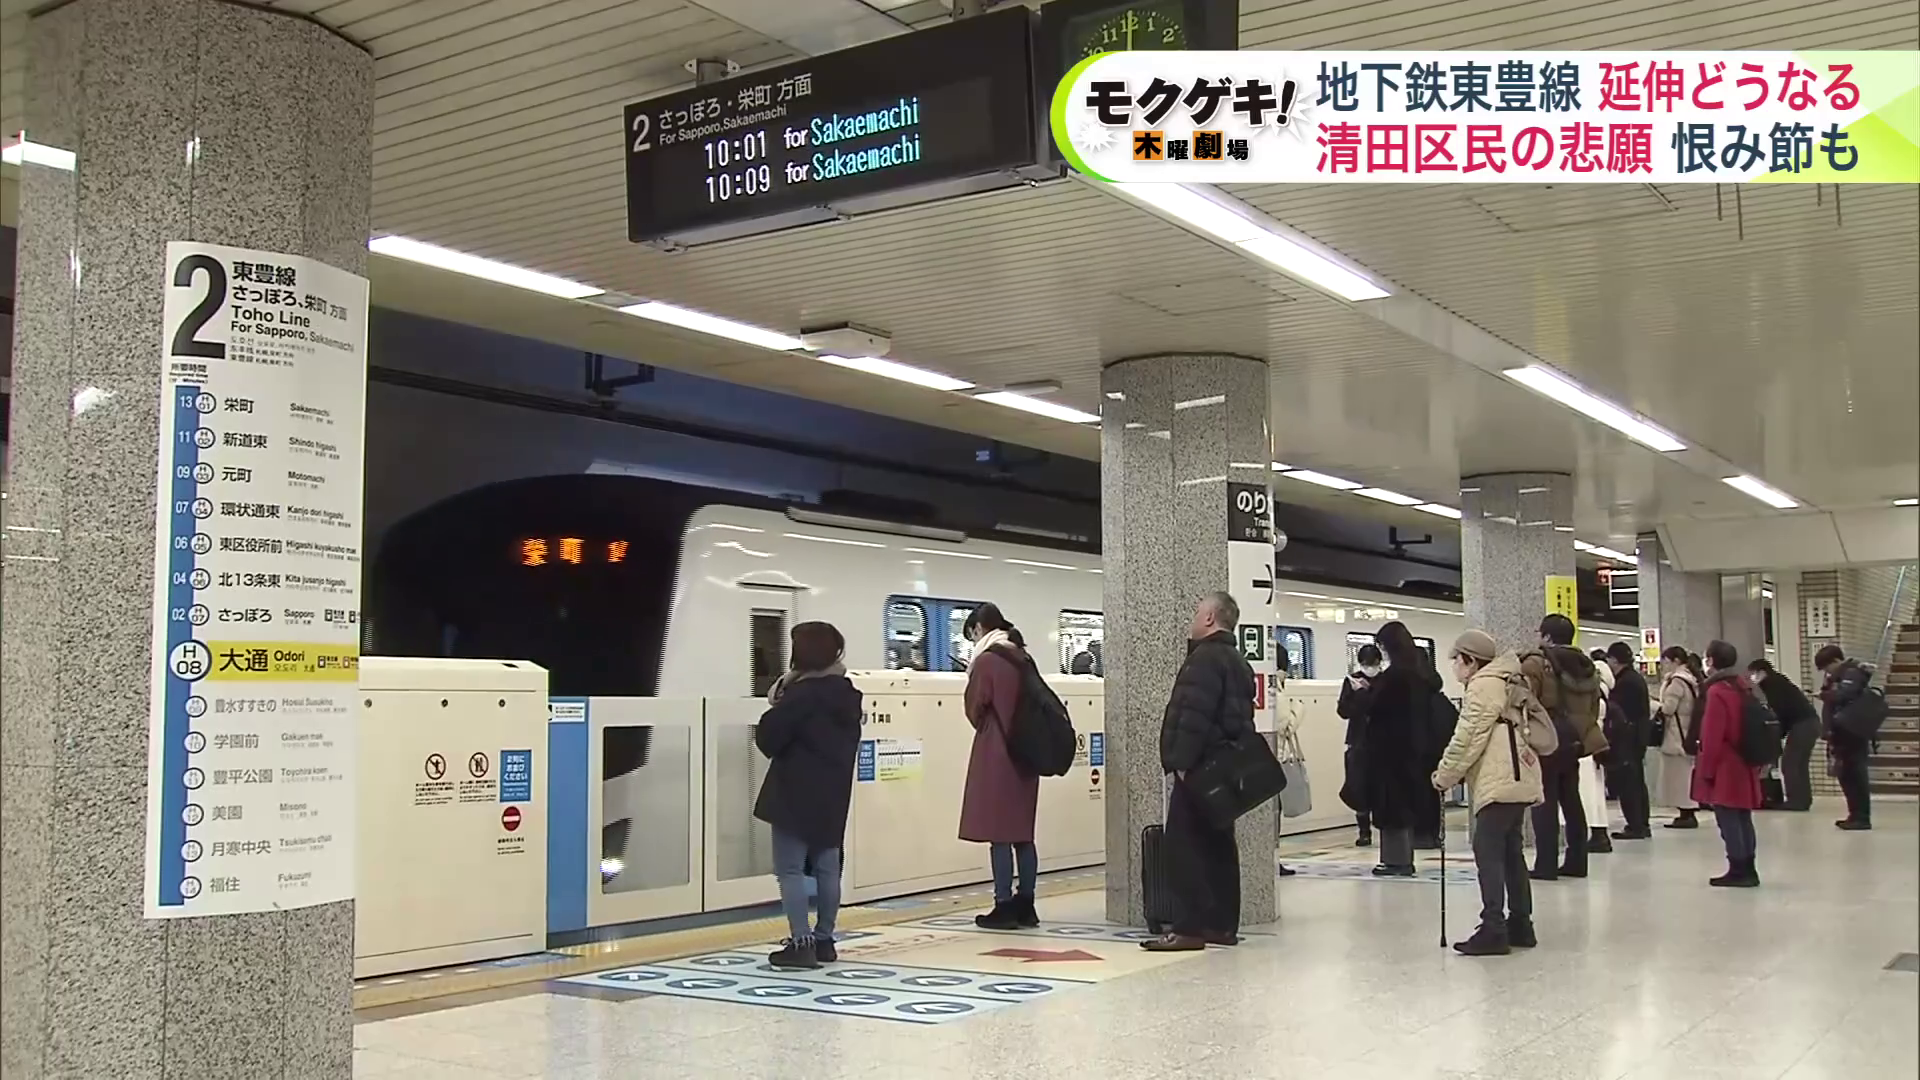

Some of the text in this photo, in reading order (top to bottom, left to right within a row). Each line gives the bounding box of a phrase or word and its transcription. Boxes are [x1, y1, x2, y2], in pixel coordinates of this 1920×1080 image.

[1120, 16, 1138, 32] 12
[1147, 17, 1155, 31] 1
[1102, 27, 1118, 43] 11
[1162, 28, 1175, 43] 2
[632, 72, 812, 152] 2 さっぽろ・栄町 方面
[659, 132, 676, 146] For
[704, 97, 919, 170] 10:01 for Sakaemachi
[706, 133, 921, 203] 10:09 for Sakaemachi
[232, 261, 297, 287] 東豊線
[171, 254, 227, 359] 2
[330, 304, 348, 322] 方面
[231, 305, 311, 328] Toho Line
[231, 321, 252, 333] For
[255, 323, 308, 340] Sapporo,
[180, 396, 193, 408] 13
[224, 397, 254, 413] 栄町
[179, 431, 190, 443] 11
[223, 432, 268, 448] 新道東
[177, 466, 190, 479] 09
[222, 467, 252, 482] 元町
[176, 501, 188, 513] 07
[220, 502, 280, 518] 環状通東
[174, 537, 187, 549] 06
[220, 537, 282, 553] 東区役所前
[173, 573, 186, 584] 04
[218, 572, 281, 588] 北13条東
[172, 609, 185, 621] 02
[218, 609, 272, 623] さっぽろ
[284, 608, 315, 619] Sapporo
[183, 645, 196, 658] H
[274, 650, 305, 662] Odori
[176, 661, 202, 675] 08
[219, 648, 269, 672] 大通
[214, 734, 260, 749] 学園前
[213, 769, 273, 785] 豊平公園
[212, 805, 242, 821] 美園
[211, 841, 271, 857] 月寒中央
[210, 877, 240, 893] 福住
